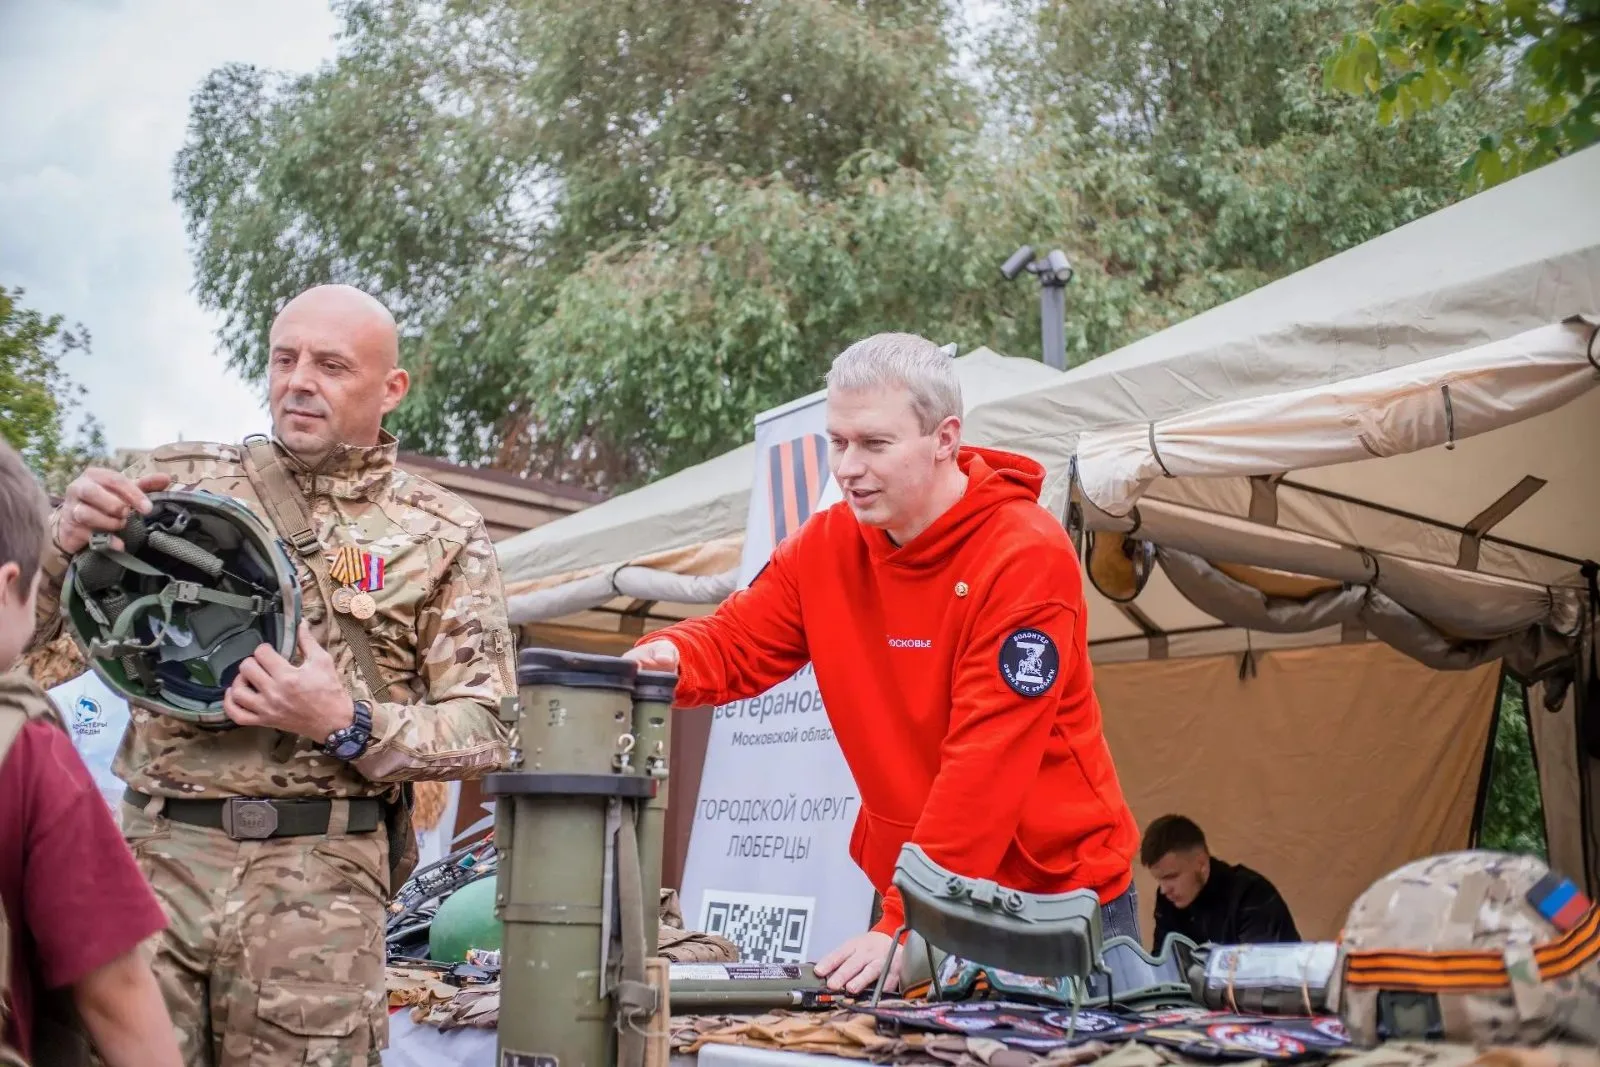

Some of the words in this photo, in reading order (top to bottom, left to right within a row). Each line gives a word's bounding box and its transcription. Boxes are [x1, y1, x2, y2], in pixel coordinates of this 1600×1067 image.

[888, 639, 932, 648] ОСКОВЬЕ
[1013, 632, 1049, 645] ВОЛОНТЕР
[732, 728, 798, 746] Московской
[801, 727, 836, 742] облас
[698, 793, 798, 824] ГОРОДСКОЙ
[801, 796, 855, 822] ОКРУГ
[726, 835, 812, 863] ЛЮБЕРЦЫ
